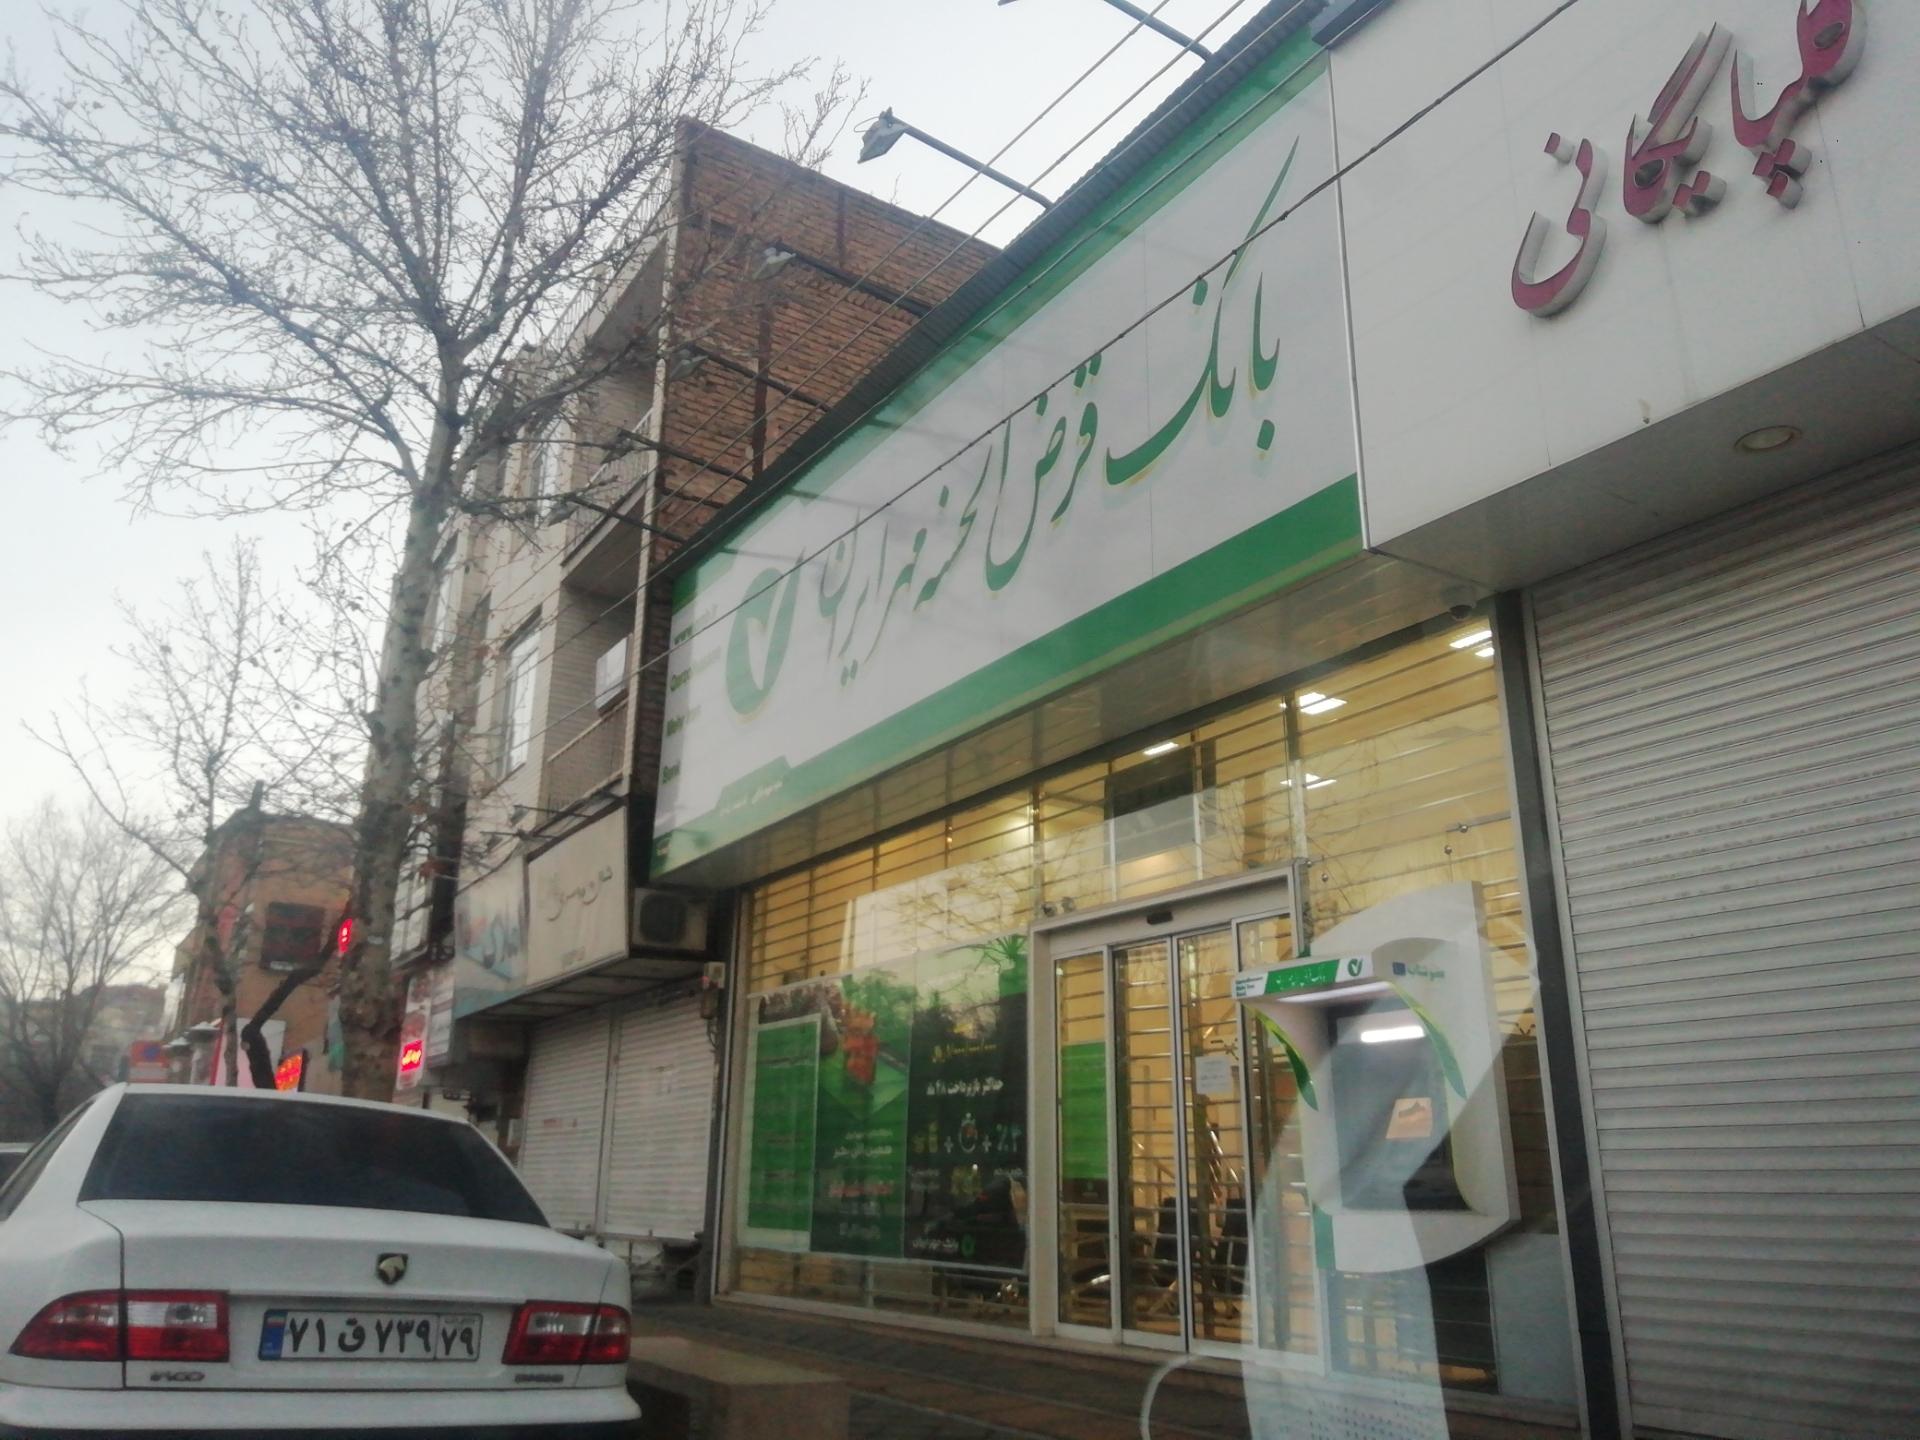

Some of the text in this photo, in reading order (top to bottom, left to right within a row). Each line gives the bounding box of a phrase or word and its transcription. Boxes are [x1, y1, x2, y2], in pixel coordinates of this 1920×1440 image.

[818, 136, 1299, 687] بانک قرض الحسنه مهر ایران
[289, 1318, 473, 1355] ۷۱ ق ۷۳۹ ۷۹
